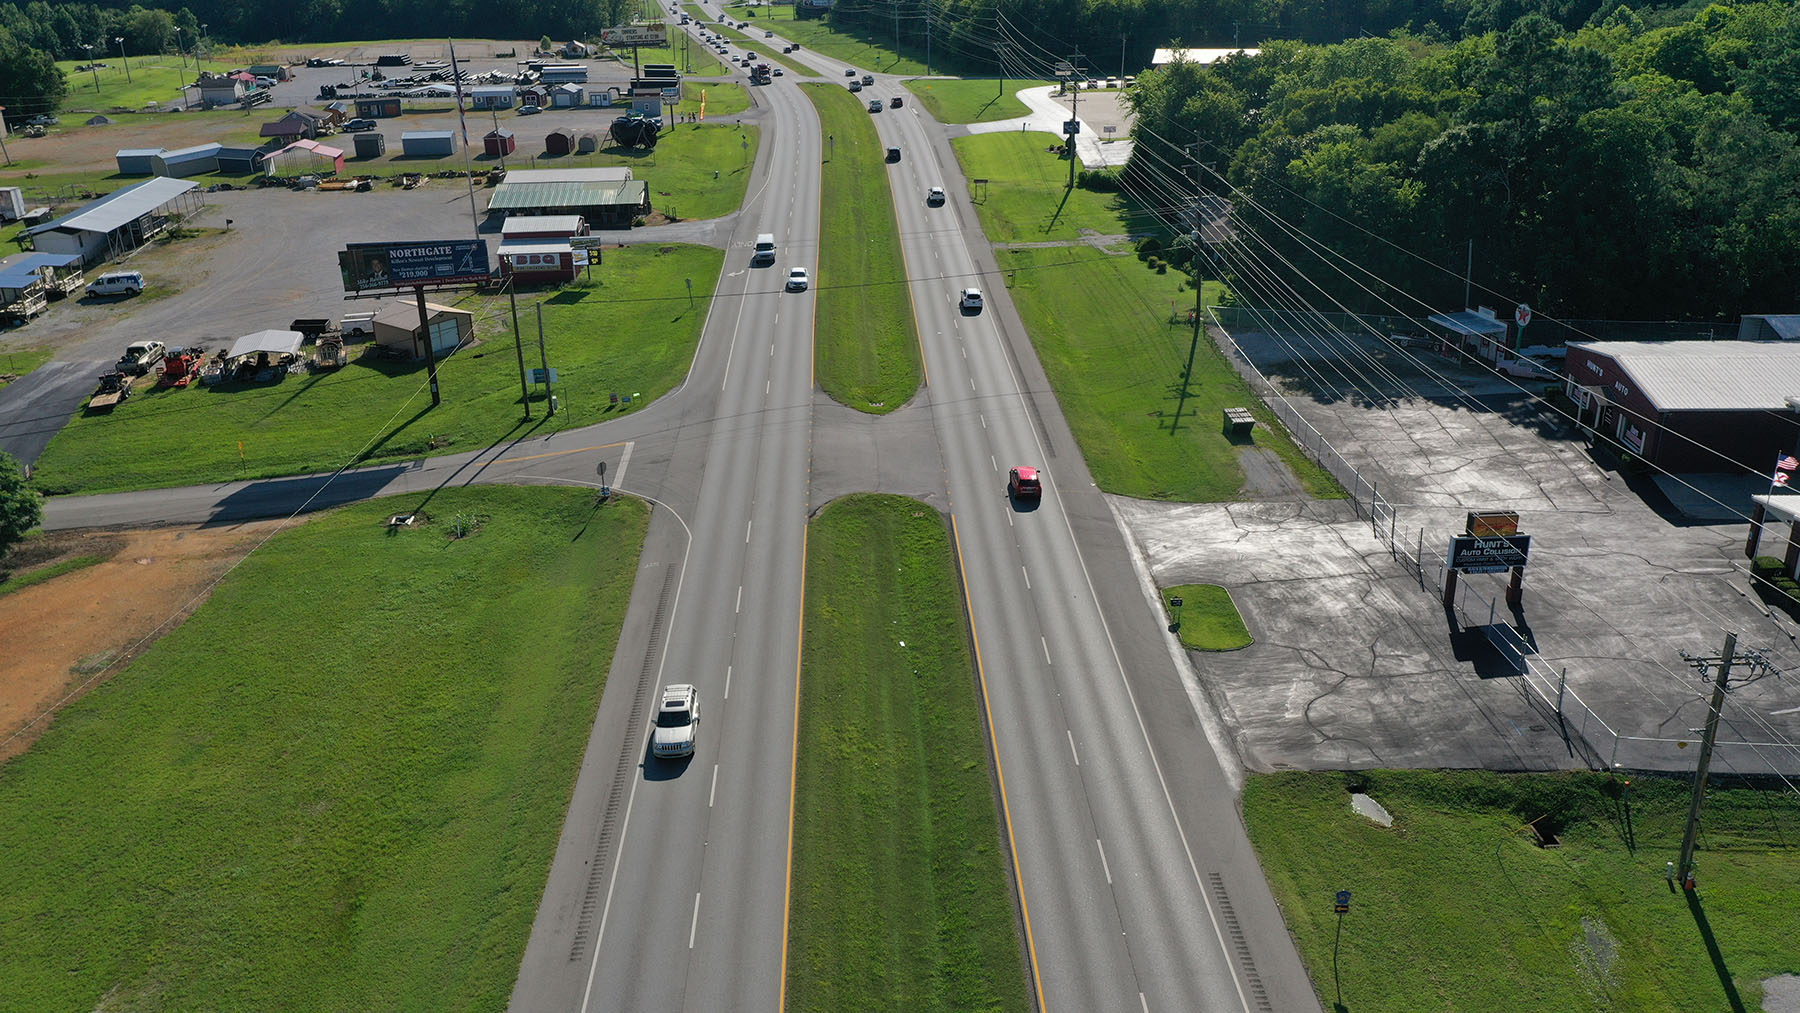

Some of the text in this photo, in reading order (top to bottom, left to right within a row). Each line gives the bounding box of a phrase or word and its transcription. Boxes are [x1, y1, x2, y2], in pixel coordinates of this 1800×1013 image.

[390, 246, 452, 258] NORTHGATE
[516, 255, 555, 265] BBQ
[1586, 360, 1604, 377] HUNT'S
[1614, 381, 1629, 396] AUTO
[1474, 540, 1509, 548] HUNT'S
